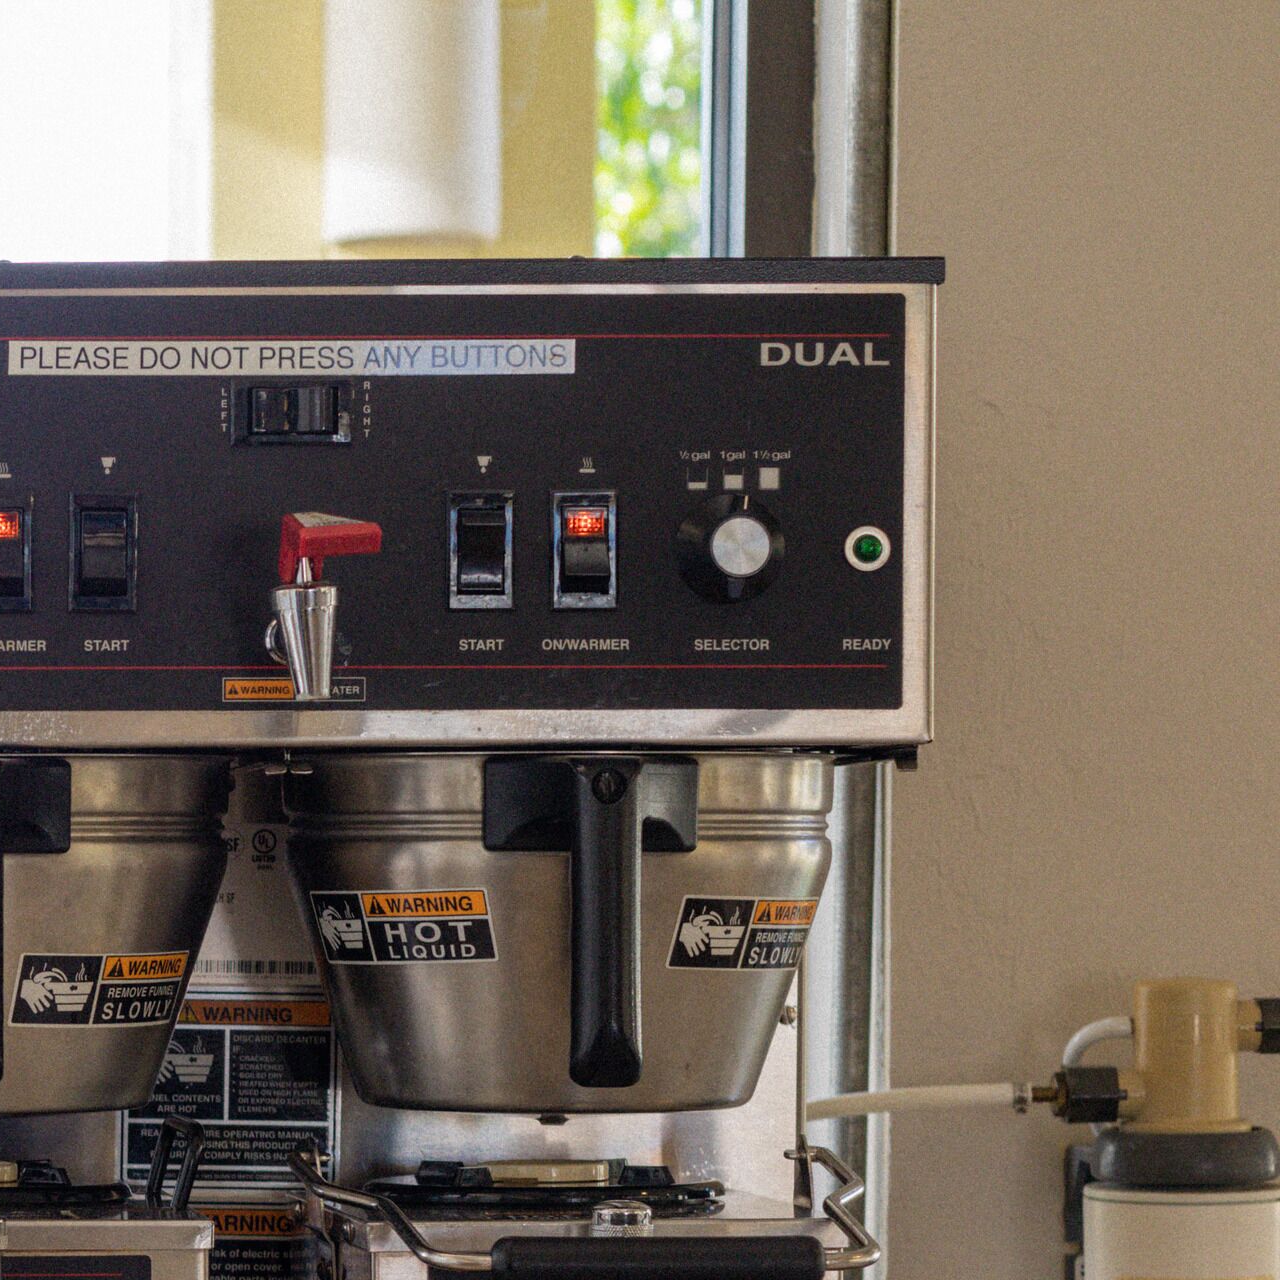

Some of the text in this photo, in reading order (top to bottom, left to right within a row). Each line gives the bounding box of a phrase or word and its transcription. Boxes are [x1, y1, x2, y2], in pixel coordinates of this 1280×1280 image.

[19, 344, 567, 370] PLEASE DO NOT PRESS ANY BUTTONS
[759, 342, 890, 367] DUAL
[363, 381, 371, 438] RIGHT
[691, 450, 711, 461] gal
[771, 450, 791, 461] gal
[84, 638, 130, 652] START
[459, 637, 504, 651] START
[542, 637, 630, 651] ON/WARMER
[694, 637, 770, 652] SELECTOR
[842, 637, 891, 651] READY
[241, 686, 290, 695] WARNING
[385, 896, 473, 913] WARNING
[384, 921, 473, 943] HOT
[390, 943, 476, 959] LIQUID
[128, 958, 182, 975] WARNING
[108, 986, 147, 999] REMOVE
[101, 1000, 172, 1020] SLOWLY
[203, 1006, 293, 1023] WARNING
[233, 1035, 274, 1043] DISCARD
[171, 1094, 222, 1103] CONTENTS
[157, 1104, 197, 1113] ARE HOT
[223, 1131, 276, 1139] OPERATING
[277, 1131, 315, 1140] MANUAL
[230, 1141, 250, 1149] THIS
[252, 1141, 297, 1150] PRODUCT
[204, 1151, 241, 1160] COMPLY
[243, 1151, 271, 1160] RISKS
[209, 1214, 294, 1233] ARNING
[229, 1249, 240, 1258] of
[242, 1249, 280, 1259] electric
[210, 1263, 221, 1271] or
[224, 1263, 250, 1273] open
